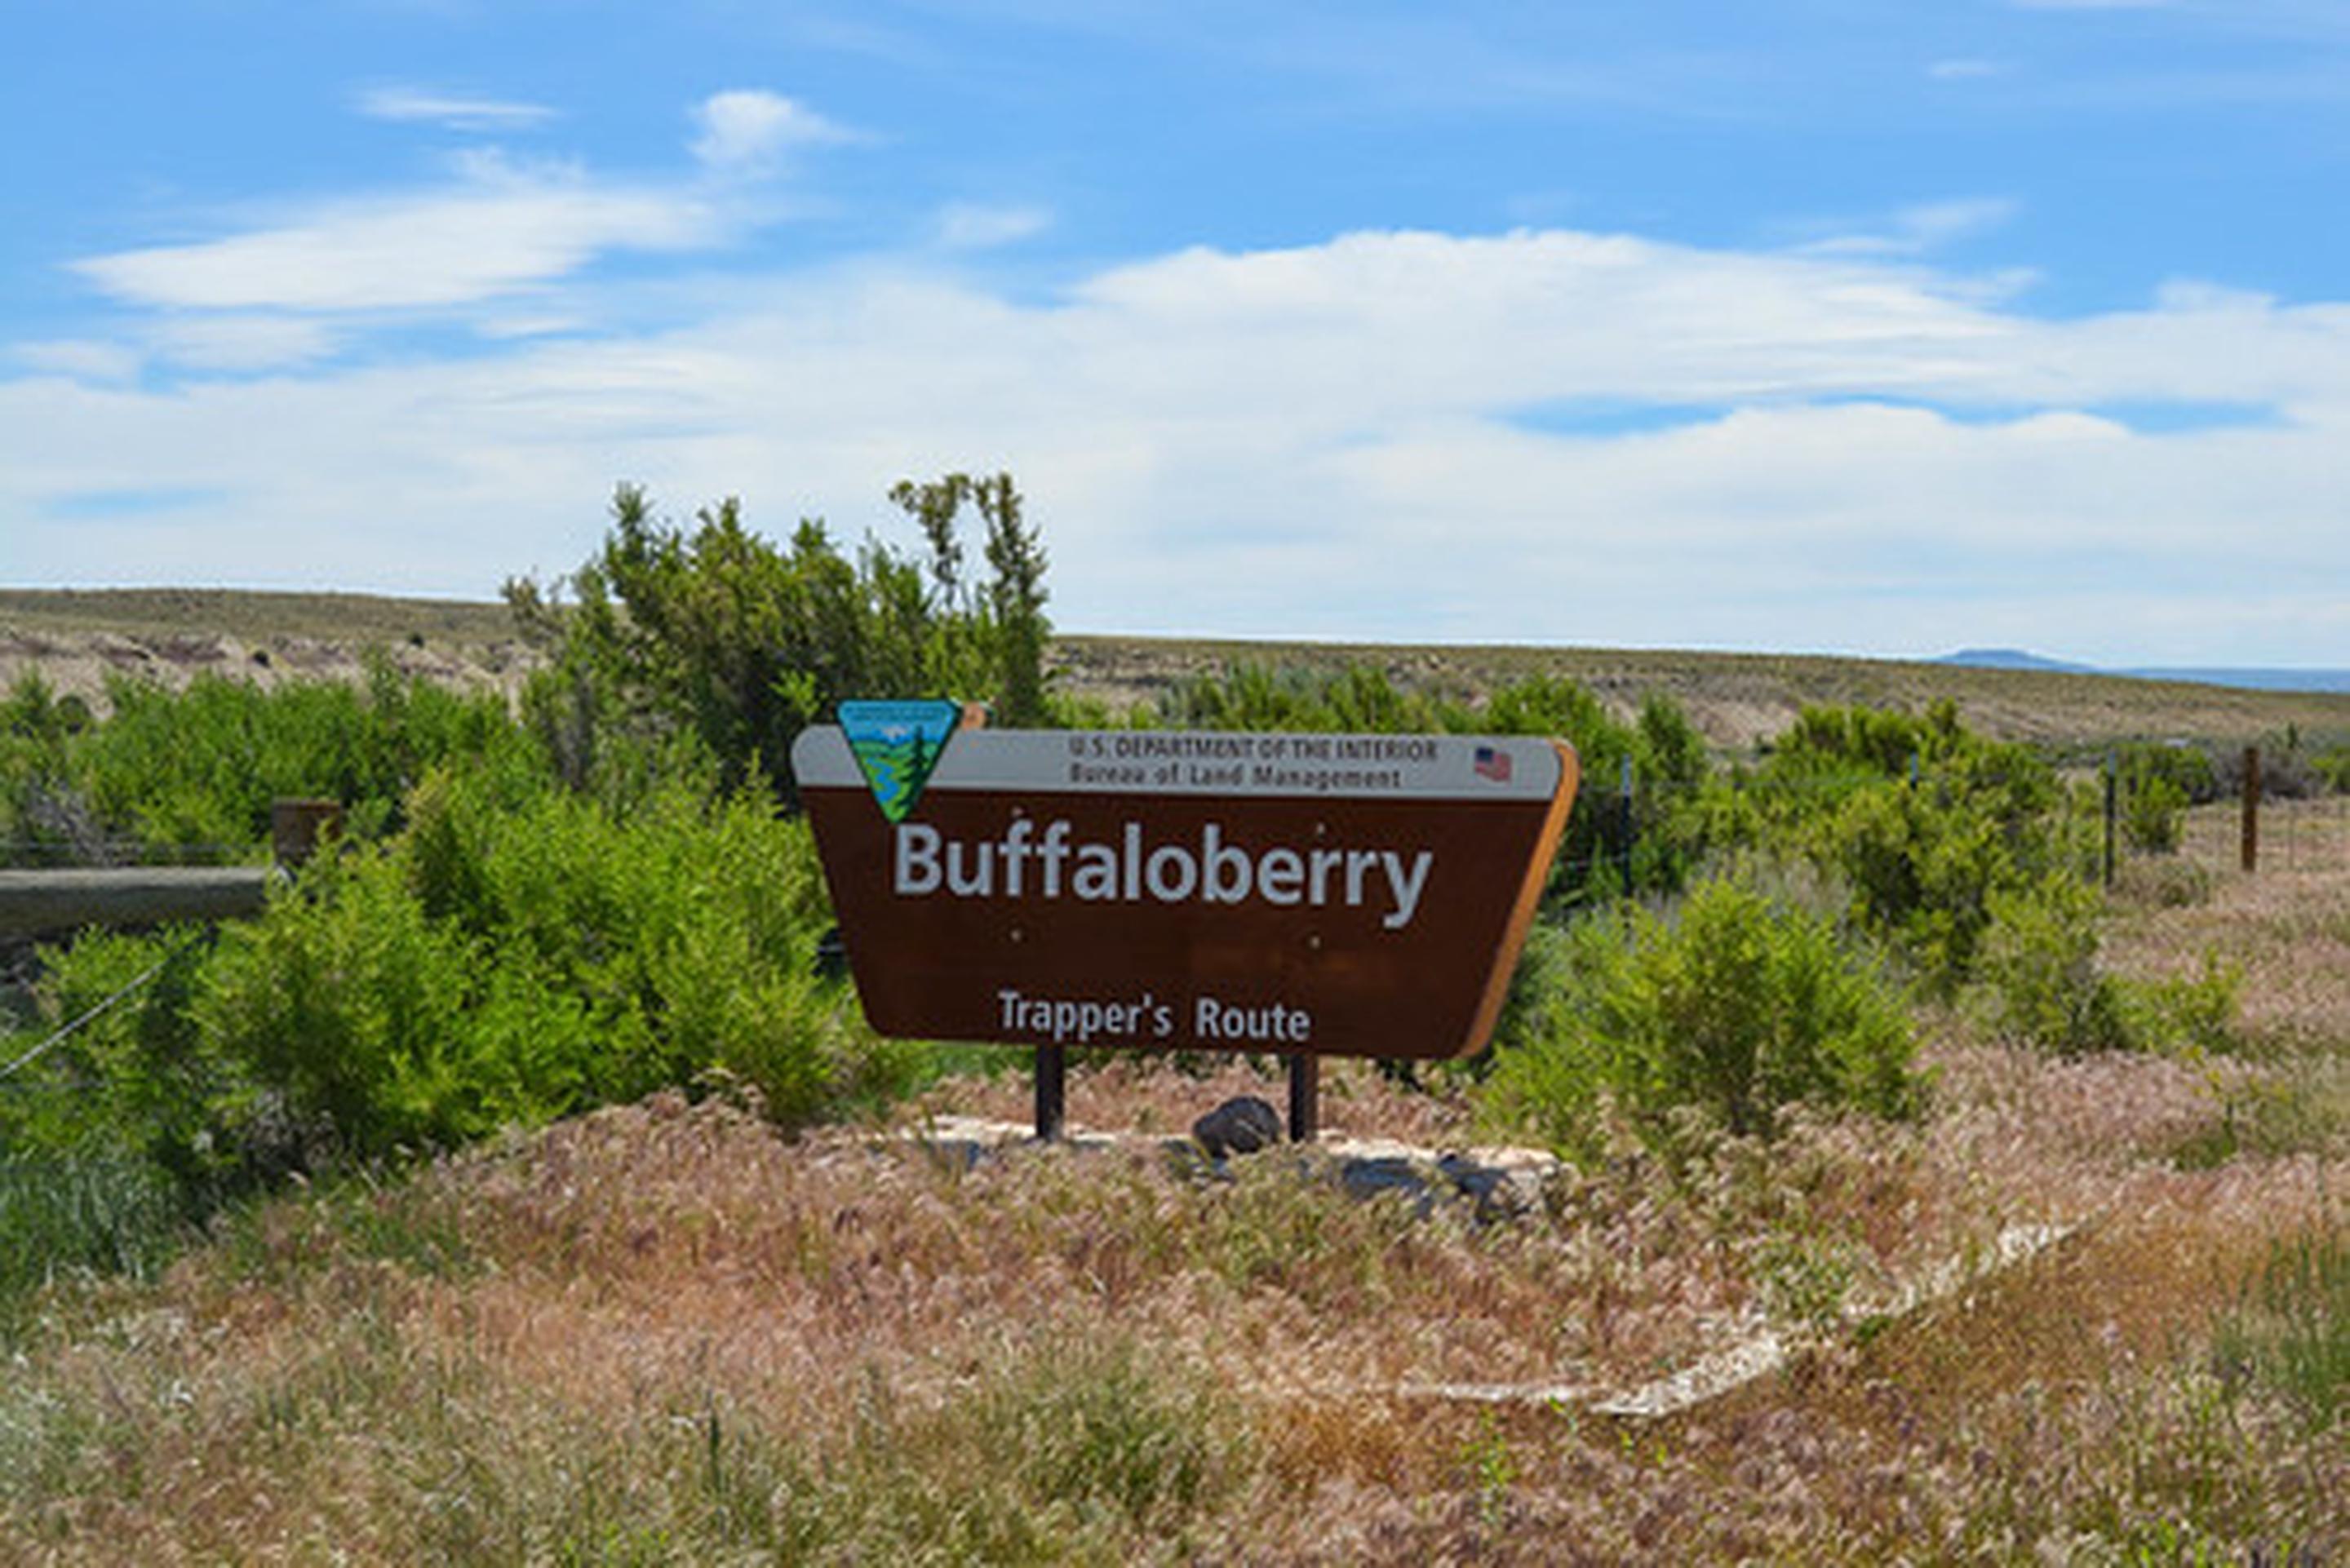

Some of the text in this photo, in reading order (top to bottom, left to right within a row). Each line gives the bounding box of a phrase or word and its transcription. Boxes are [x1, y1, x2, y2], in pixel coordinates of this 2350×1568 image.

[1115, 737, 1253, 759] DEPARTMENT
[1258, 738, 1287, 760] OF
[1292, 738, 1332, 760] THE
[1337, 739, 1437, 762] INTERIOR
[1071, 762, 1401, 791] Bureau of Land Management
[894, 819, 1433, 929] Buffaloberry
[998, 990, 1312, 1042] Trapper's Route
